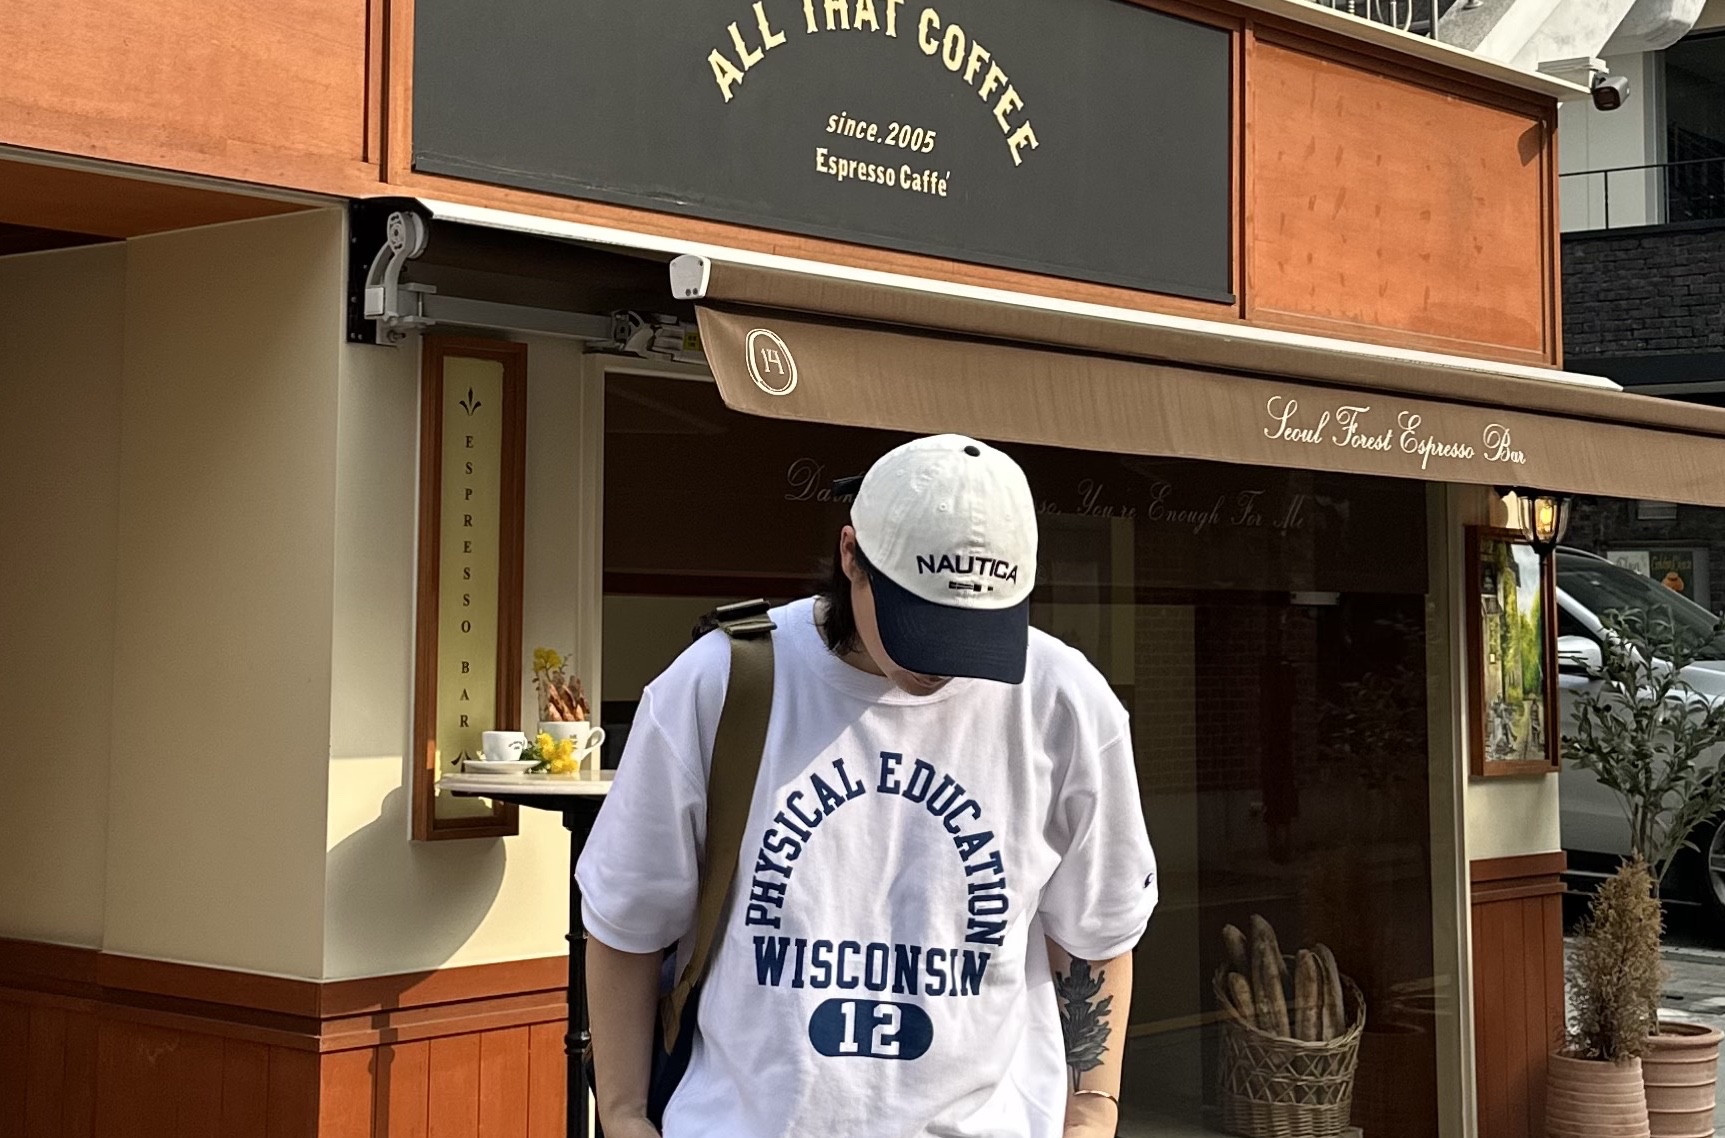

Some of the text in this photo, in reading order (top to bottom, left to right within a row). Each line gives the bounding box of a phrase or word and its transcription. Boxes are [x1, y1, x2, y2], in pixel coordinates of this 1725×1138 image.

[707, 1, 787, 102] ALL
[918, 8, 1040, 166] COFFEE
[826, 111, 937, 154] since.2005
[816, 147, 896, 187] Espresso
[1264, 395, 1526, 470] Seoul Forest Espresso Bar
[1148, 481, 1225, 534] Enough
[1231, 490, 1265, 527] For
[459, 435, 474, 728] ESPRESSO BAR
[916, 554, 1018, 585] NAUTICA
[745, 751, 1009, 947] PHYSICAL EDUCATION
[753, 935, 991, 997] WISCONSIN
[839, 1001, 902, 1056] 12
